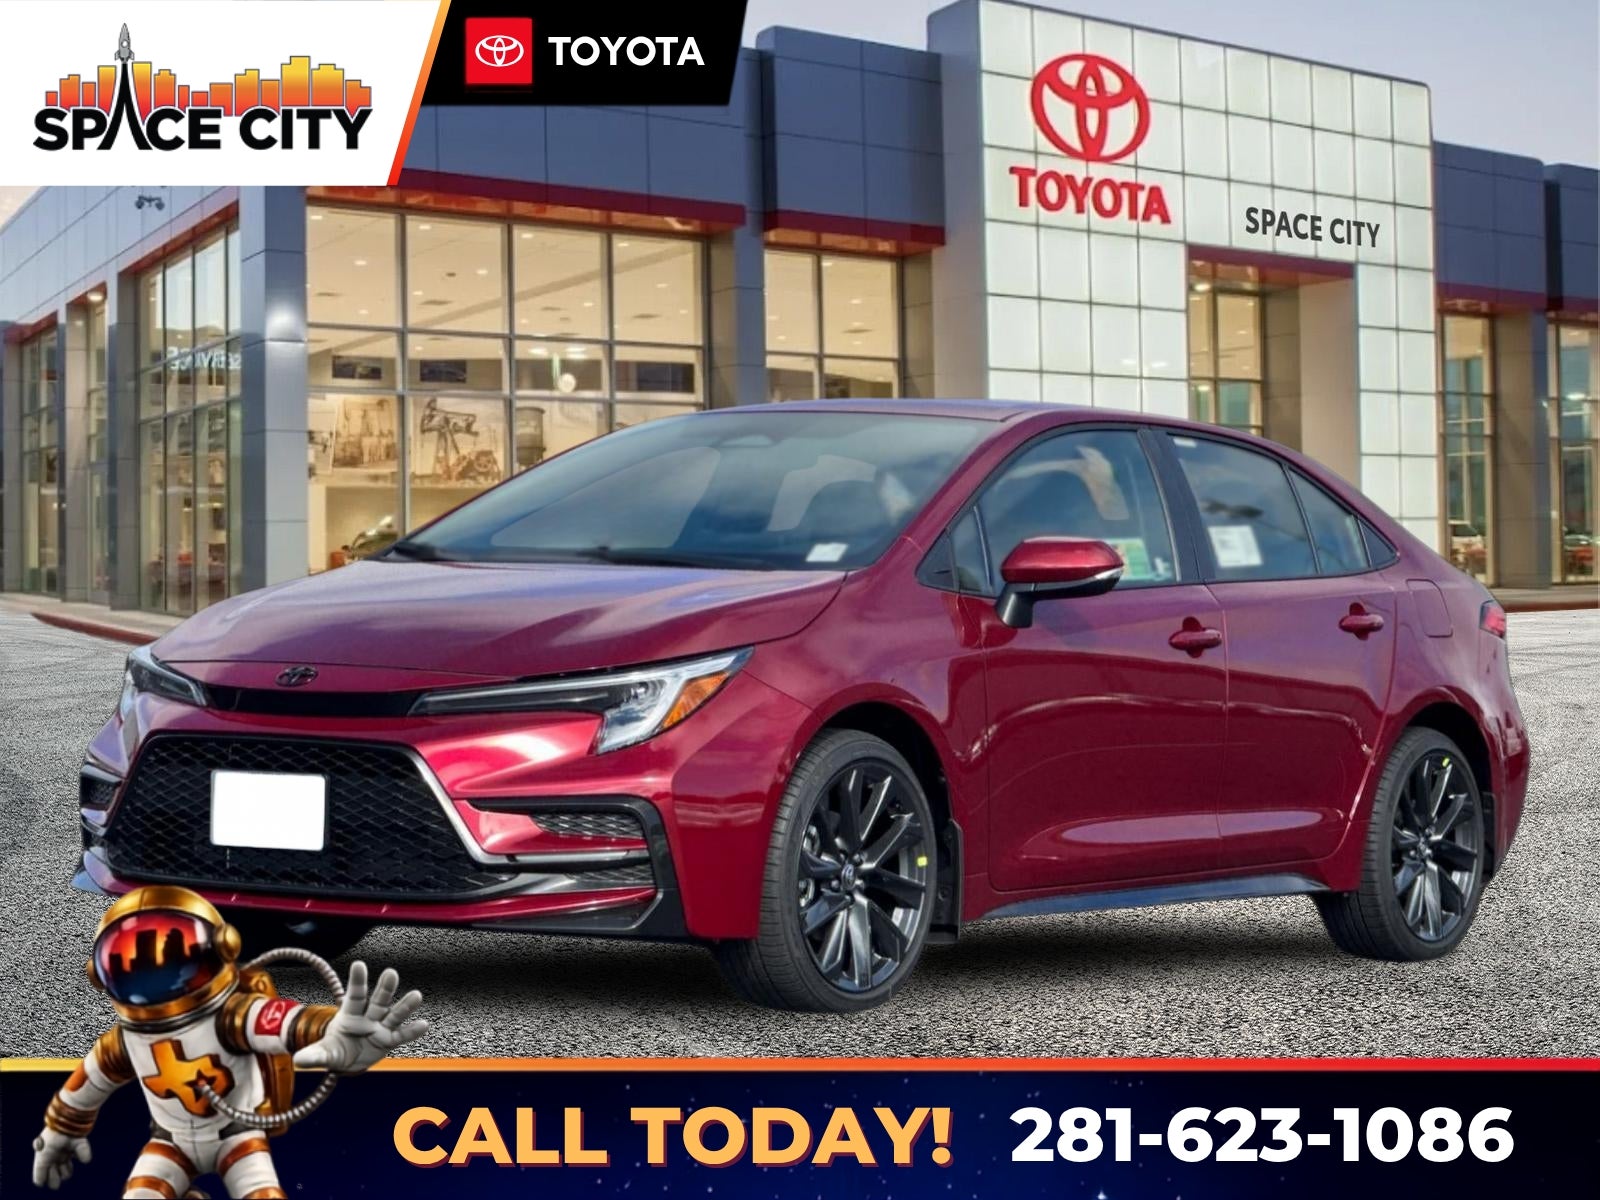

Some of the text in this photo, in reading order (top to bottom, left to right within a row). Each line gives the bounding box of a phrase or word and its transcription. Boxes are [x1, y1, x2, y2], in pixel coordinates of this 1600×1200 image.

[1009, 166, 1171, 224] TOYOTA
[1245, 206, 1381, 248] SPACE CITY
